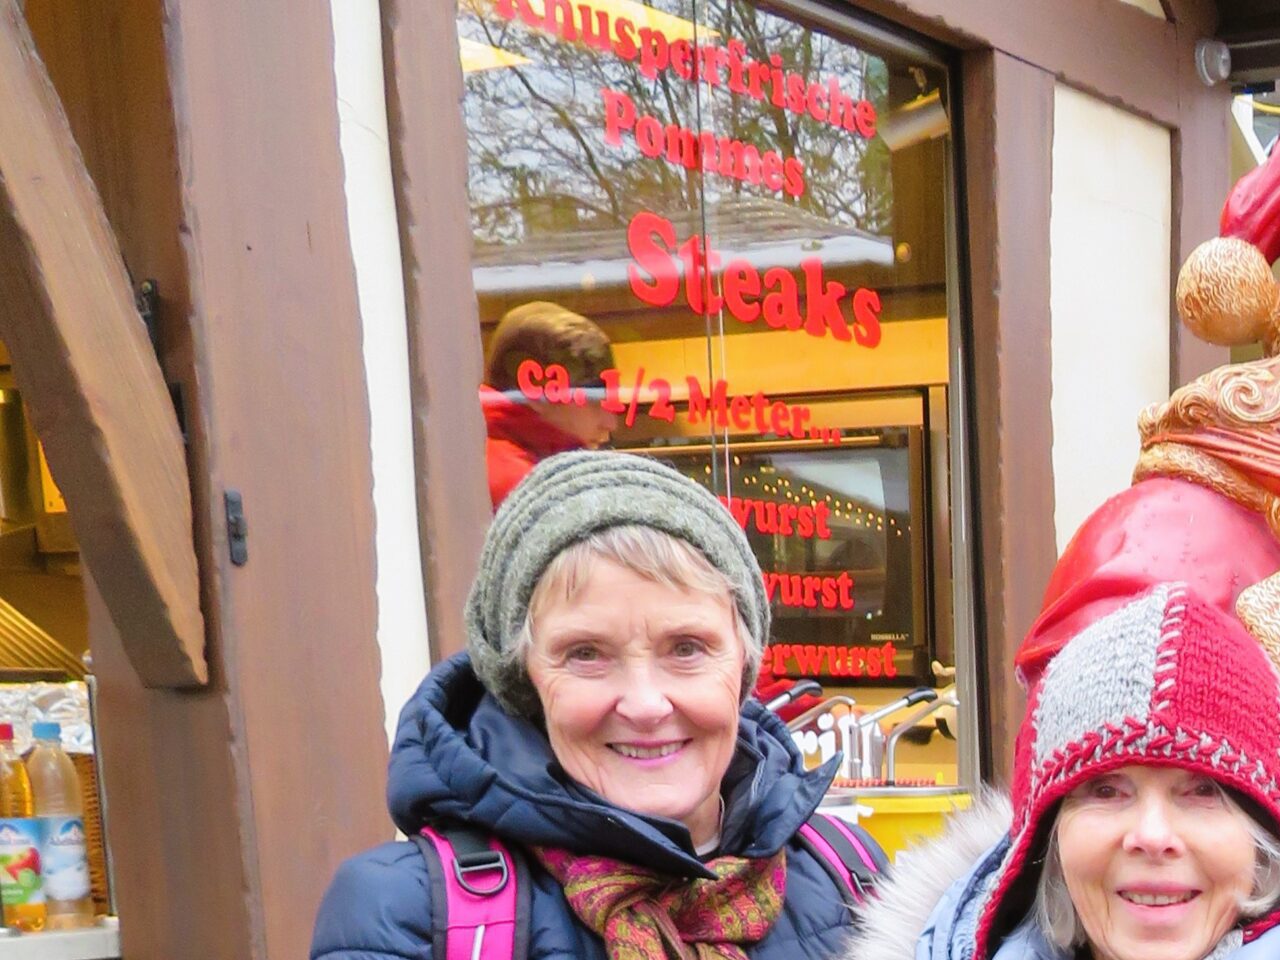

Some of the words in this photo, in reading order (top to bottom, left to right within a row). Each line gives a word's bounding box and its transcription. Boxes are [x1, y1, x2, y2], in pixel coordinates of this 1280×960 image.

[603, 87, 805, 197] Pommes
[627, 210, 883, 349] Steaks
[517, 359, 587, 406] ca.
[601, 367, 676, 428] 1/2
[718, 496, 832, 540] wurst
[762, 571, 855, 610] urst
[759, 641, 897, 679] erwurst
